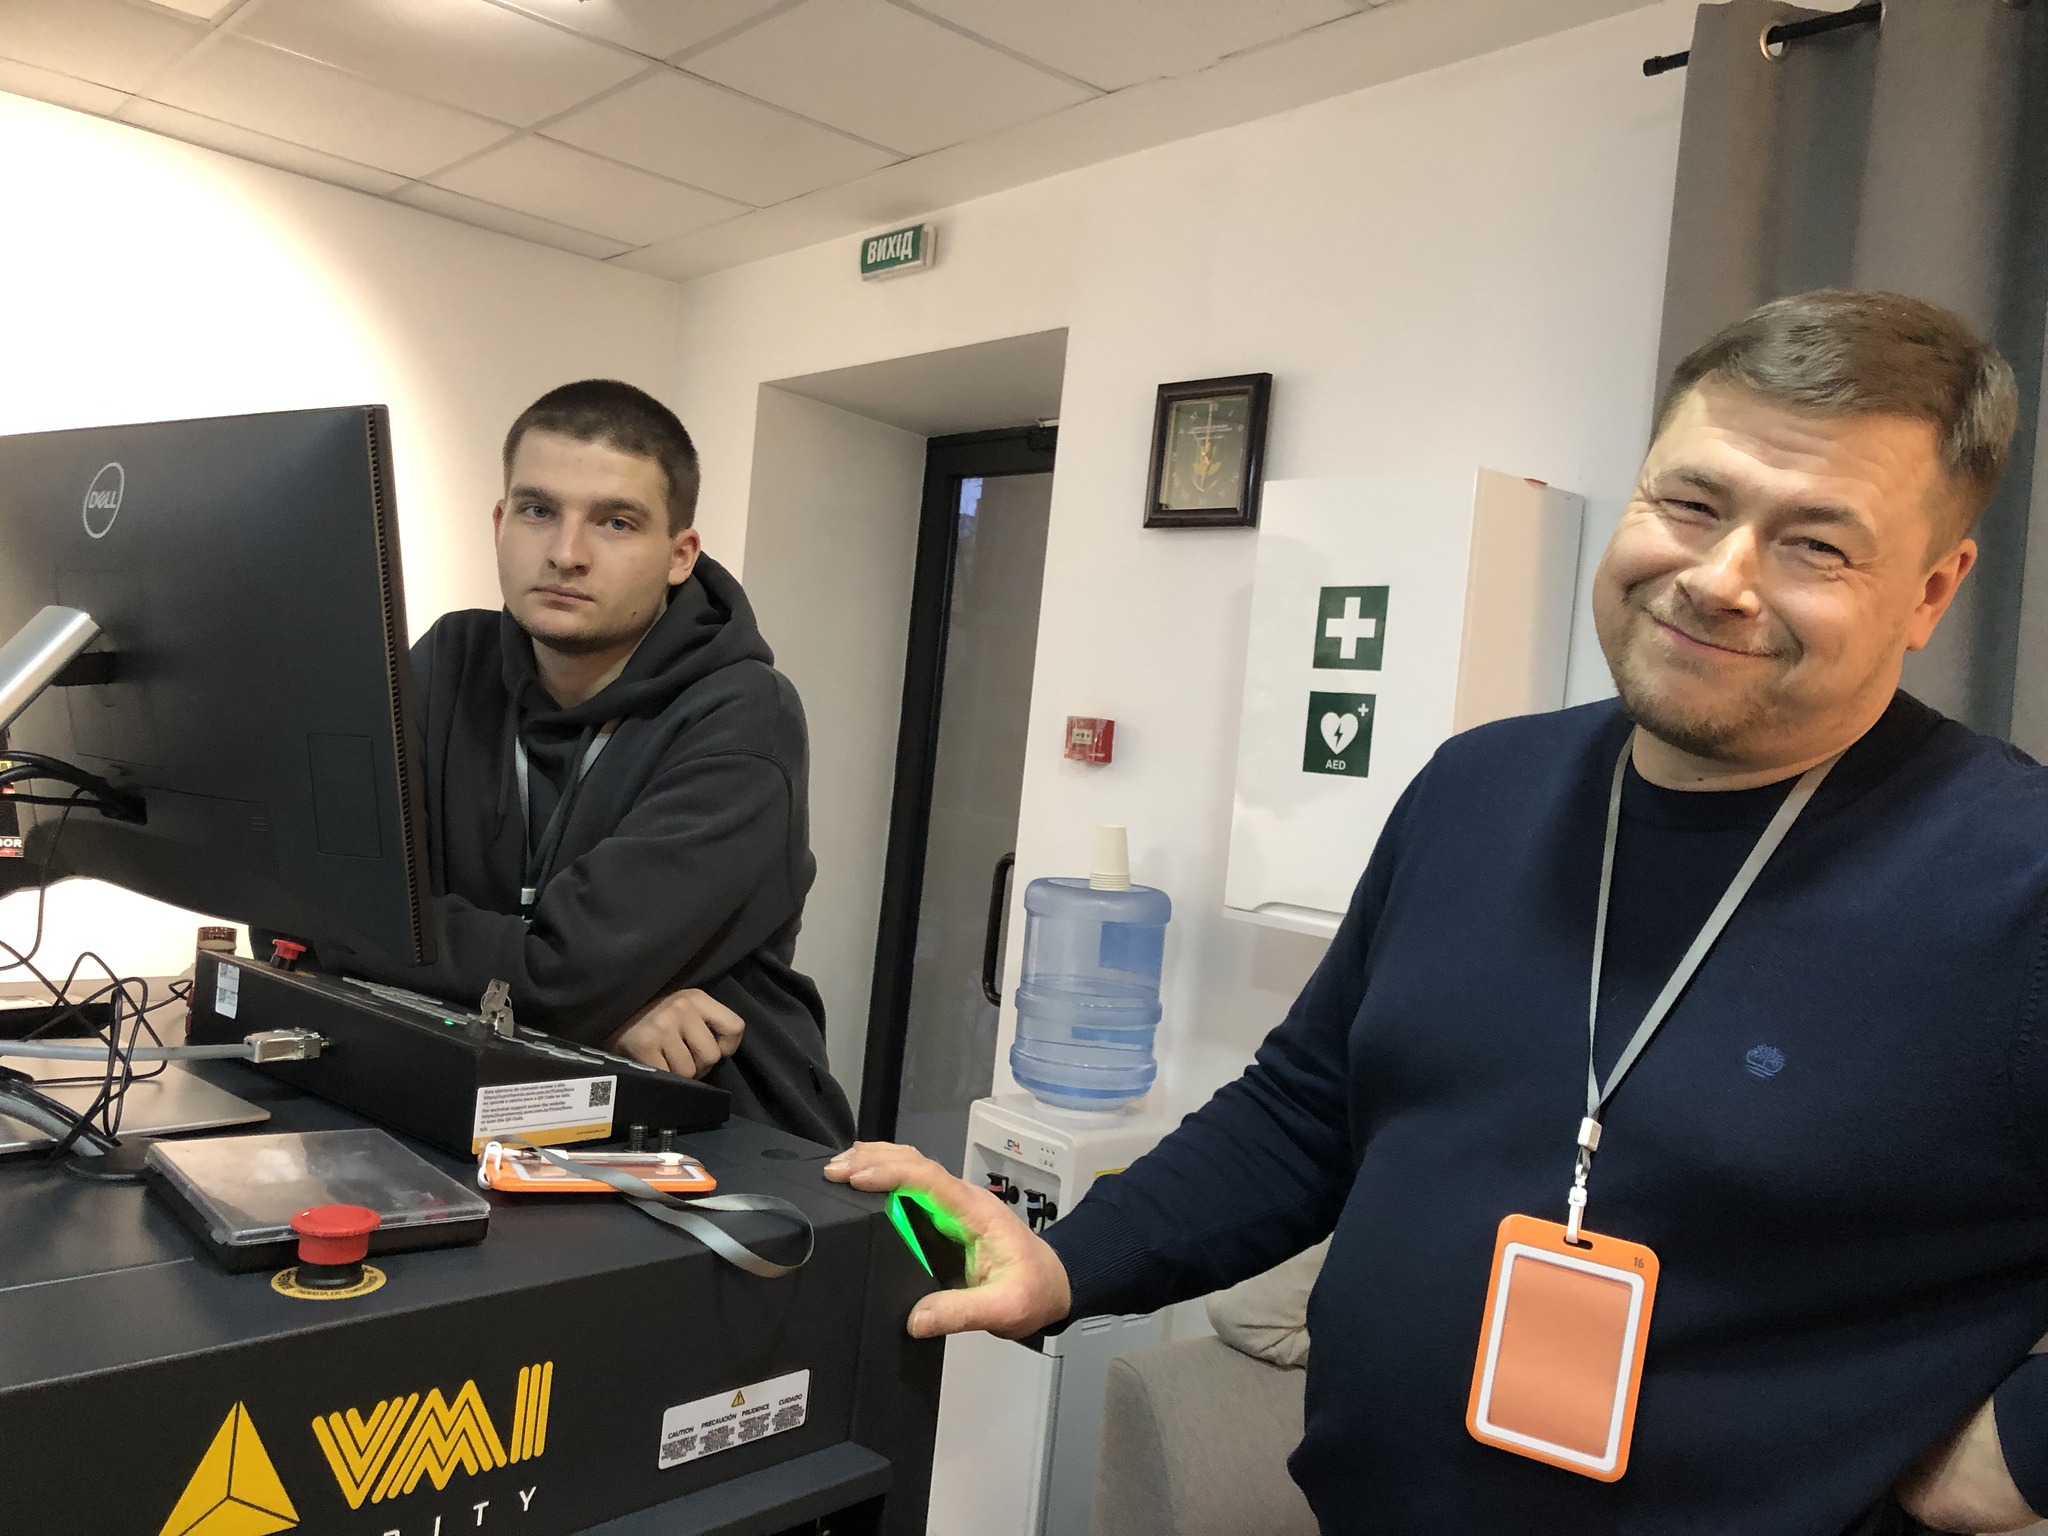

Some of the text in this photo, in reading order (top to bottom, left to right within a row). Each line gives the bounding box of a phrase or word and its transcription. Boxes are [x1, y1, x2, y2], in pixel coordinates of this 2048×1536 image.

[867, 231, 913, 264] ВИХІД
[89, 491, 117, 509] DELL
[1325, 759, 1346, 770] AED
[1634, 1256, 1644, 1268] 16
[779, 1394, 802, 1405] CUIDADO
[742, 1403, 769, 1416] PRUDENCE
[701, 1413, 737, 1428] PRECAUCIÓN
[312, 1361, 553, 1510] VMI
[668, 1426, 694, 1439] CAUTION
[383, 1486, 537, 1536] ITY
